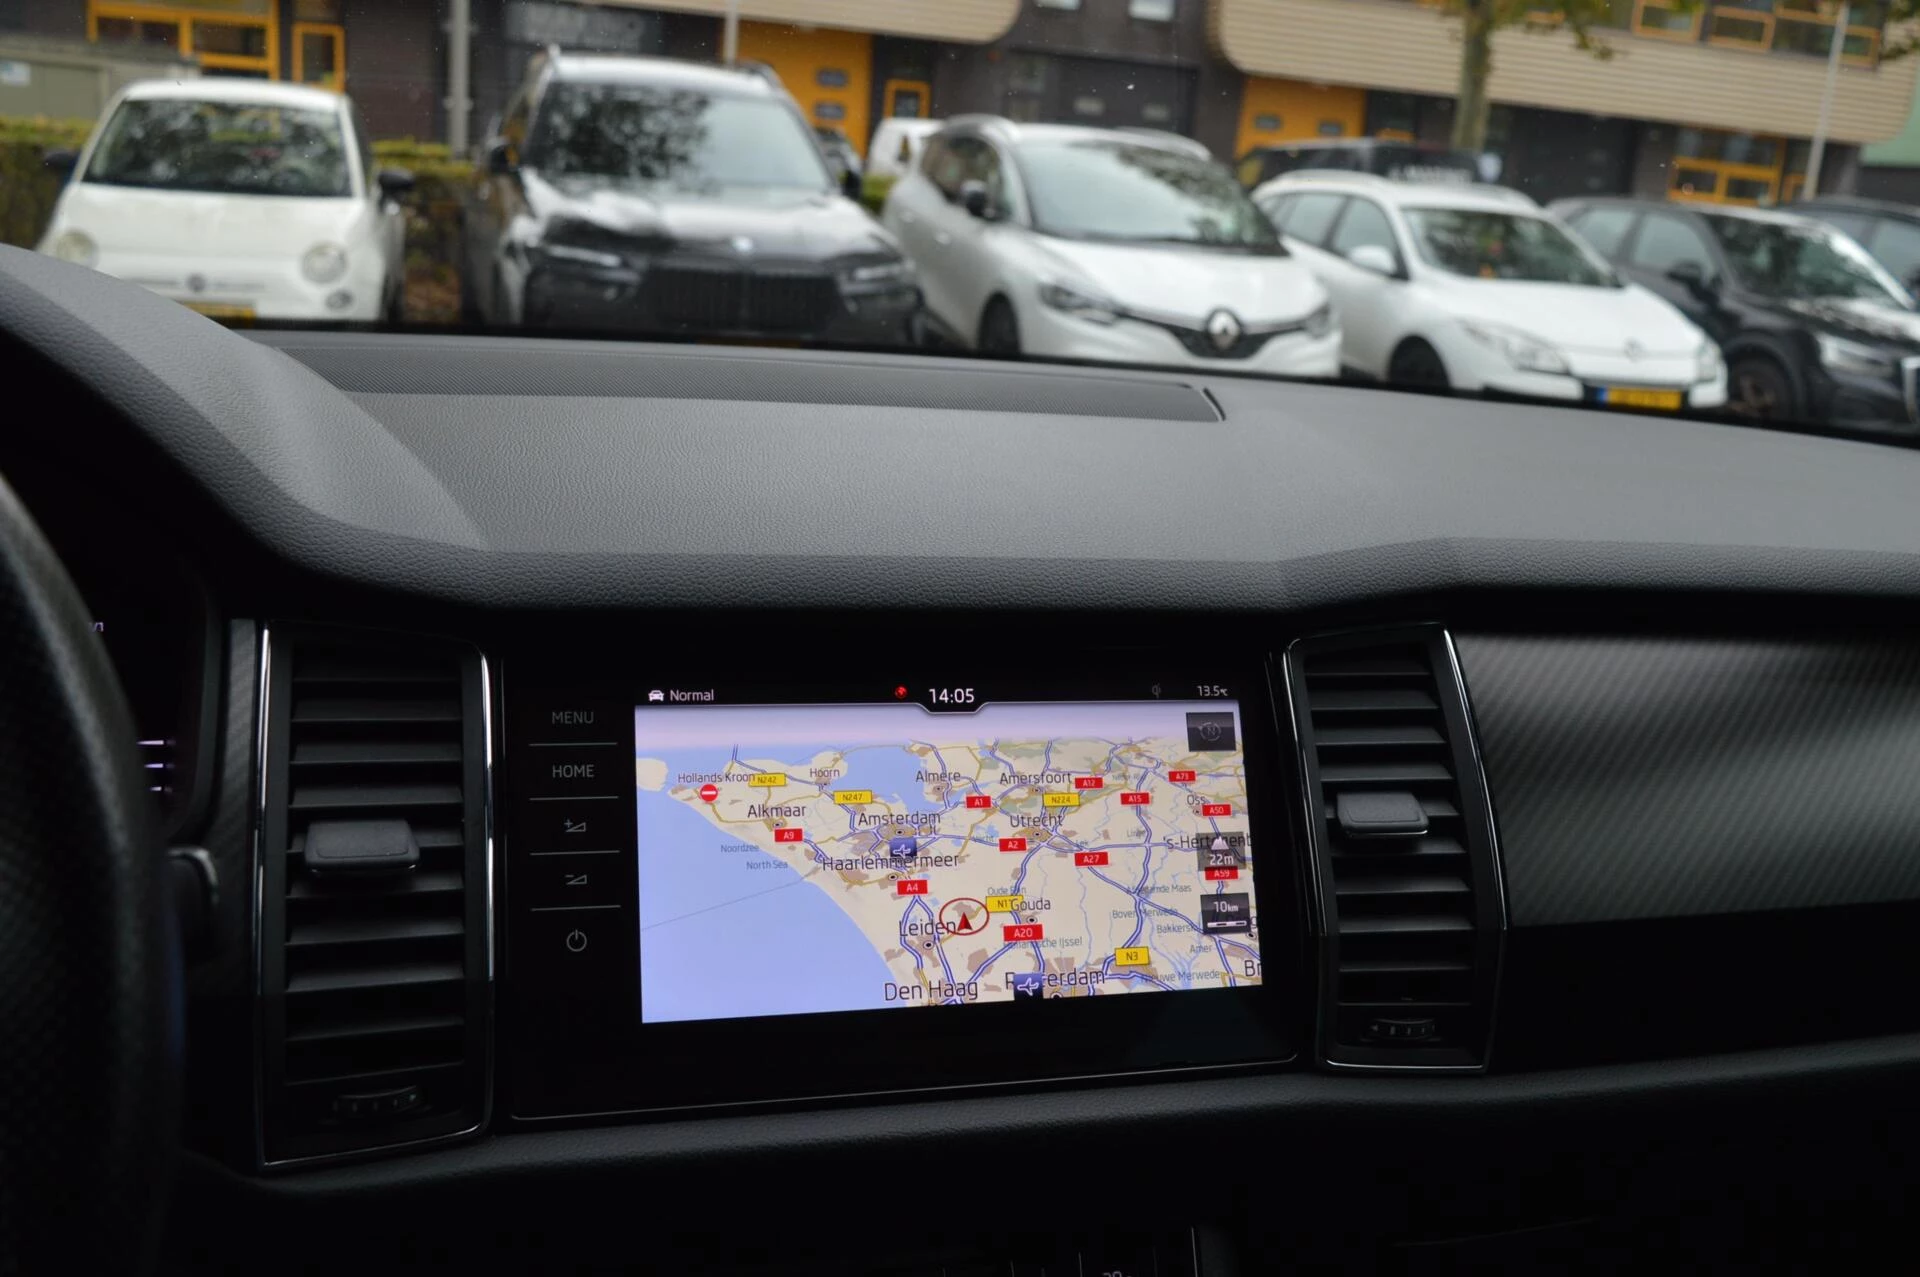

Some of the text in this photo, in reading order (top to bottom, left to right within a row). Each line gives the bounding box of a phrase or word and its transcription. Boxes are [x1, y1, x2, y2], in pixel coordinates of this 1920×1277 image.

[669, 689, 715, 702] Normal
[928, 687, 975, 704] 14:05
[551, 711, 595, 725] MENU
[552, 763, 596, 779] HOME
[677, 771, 756, 784] Hollands Kroon
[809, 767, 840, 779] Hoorn
[915, 769, 961, 783] Almere
[1000, 772, 1072, 785] Amersfoort
[842, 792, 863, 802] N247
[974, 797, 983, 807] A1
[1186, 794, 1207, 806] Oss
[747, 804, 807, 819] Alkmaar
[1208, 806, 1224, 815] A50
[858, 812, 941, 827] Amsterdam
[1009, 813, 1063, 828] Utrecht
[783, 831, 795, 841] A9
[720, 843, 760, 854] Noordzee
[1007, 840, 1019, 849] A2
[746, 859, 789, 871] North Sea
[822, 854, 960, 871] Haarlemmermeer
[1082, 854, 1100, 864] A27
[1209, 853, 1234, 867] 22m
[905, 882, 919, 893] A4
[1009, 897, 1051, 912] Gouda
[1213, 900, 1239, 913] 10km
[899, 919, 956, 937] Leiden
[1013, 927, 1033, 939] A20
[1125, 950, 1139, 962] N3
[1005, 967, 1106, 991] Rerdam
[884, 978, 979, 1002] Den Haag
